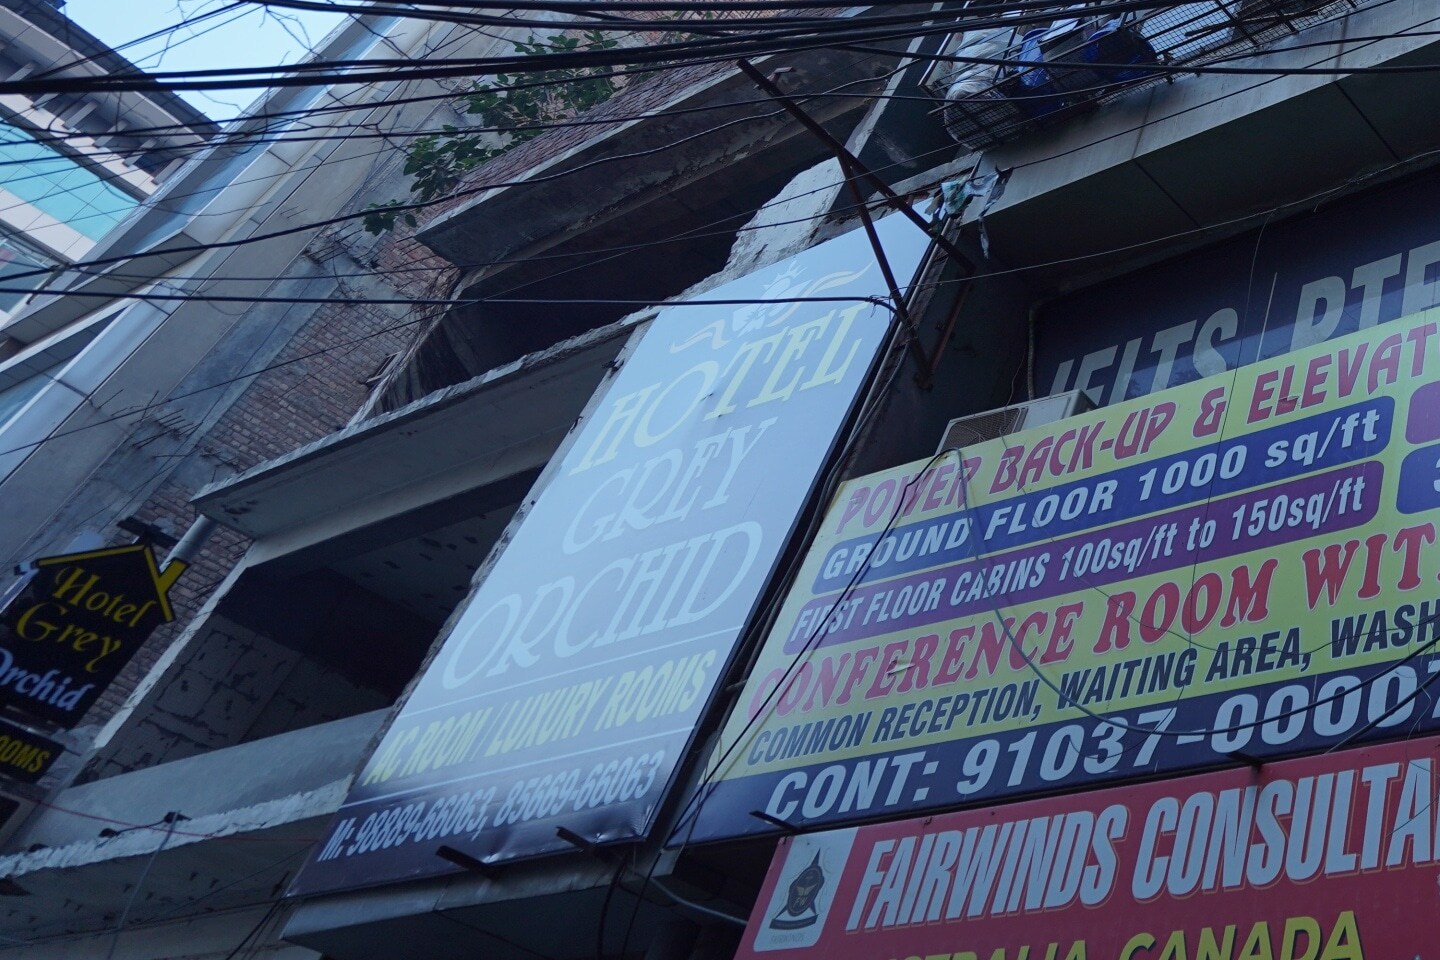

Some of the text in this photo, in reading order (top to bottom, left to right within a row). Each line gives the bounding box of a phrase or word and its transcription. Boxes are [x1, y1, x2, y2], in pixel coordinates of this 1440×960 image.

[568, 301, 869, 477] HOTEL
[562, 416, 779, 556] GREY
[822, 408, 1383, 582] GROUND FLOOR 1000 sq/ft
[836, 456, 982, 535] POWER
[988, 402, 1177, 495] BACK-UP
[1191, 387, 1227, 438] &
[52, 566, 157, 628] Hotel
[442, 520, 763, 690] ORCHID
[789, 475, 1366, 643] FIRST FLOOR CABINS 100sq/ft to 150sq/ft
[16, 602, 122, 673] Grey
[746, 711, 870, 766] COMMON
[872, 681, 1043, 742] RECEPTION,
[1055, 646, 1194, 711] WAITING
[1204, 627, 1312, 684] AREA,
[747, 602, 1085, 721] CONFERENCE
[1093, 557, 1280, 656] ROOM
[363, 729, 414, 786] AC
[400, 706, 494, 777] ROOM
[485, 674, 612, 758] LUXURY
[602, 649, 717, 730] ROOMS
[764, 751, 938, 823] CONT:
[845, 802, 1128, 932] FAIRWINDS
